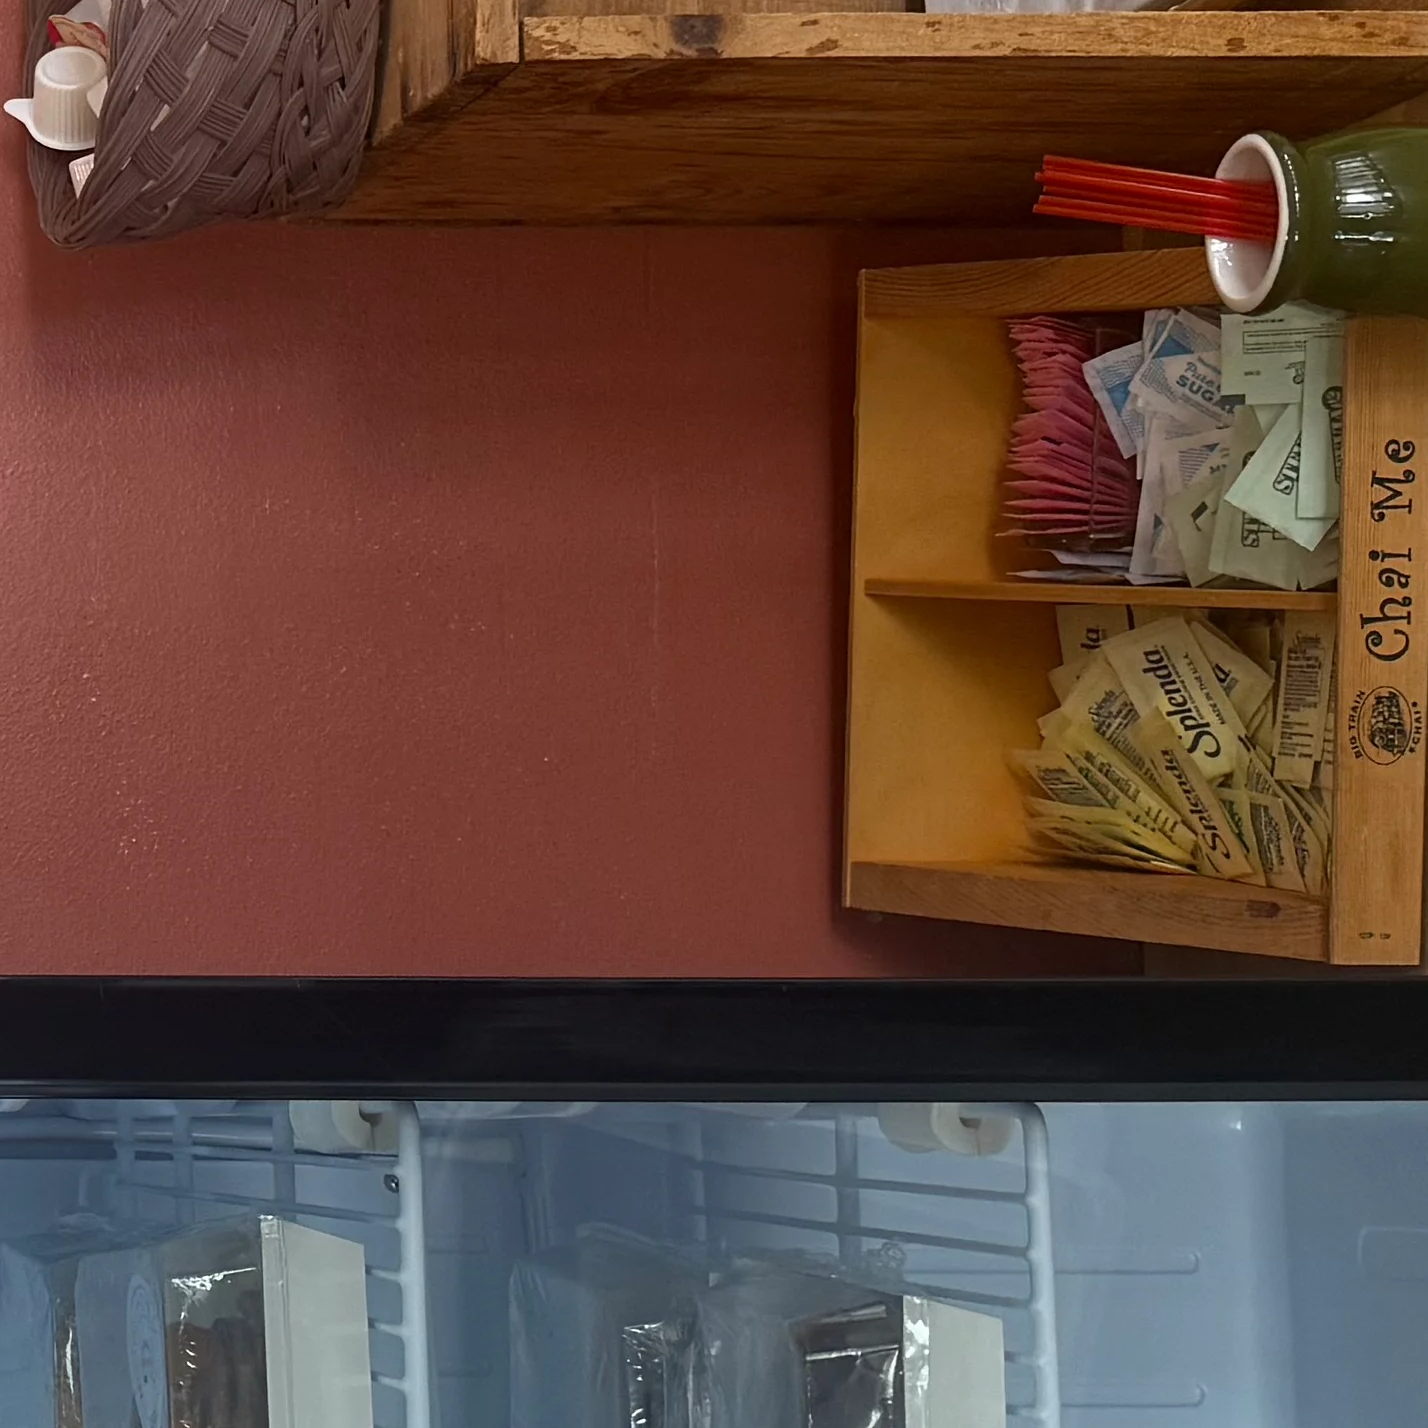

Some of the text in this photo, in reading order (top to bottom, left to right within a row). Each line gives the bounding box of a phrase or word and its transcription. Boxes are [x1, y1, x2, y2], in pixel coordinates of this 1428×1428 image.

[1360, 438, 1416, 662] Chai Me
[1141, 648, 1221, 758] Splenda
[1347, 690, 1366, 759] BIG TRAIN
[1160, 749, 1231, 859] Splenda
